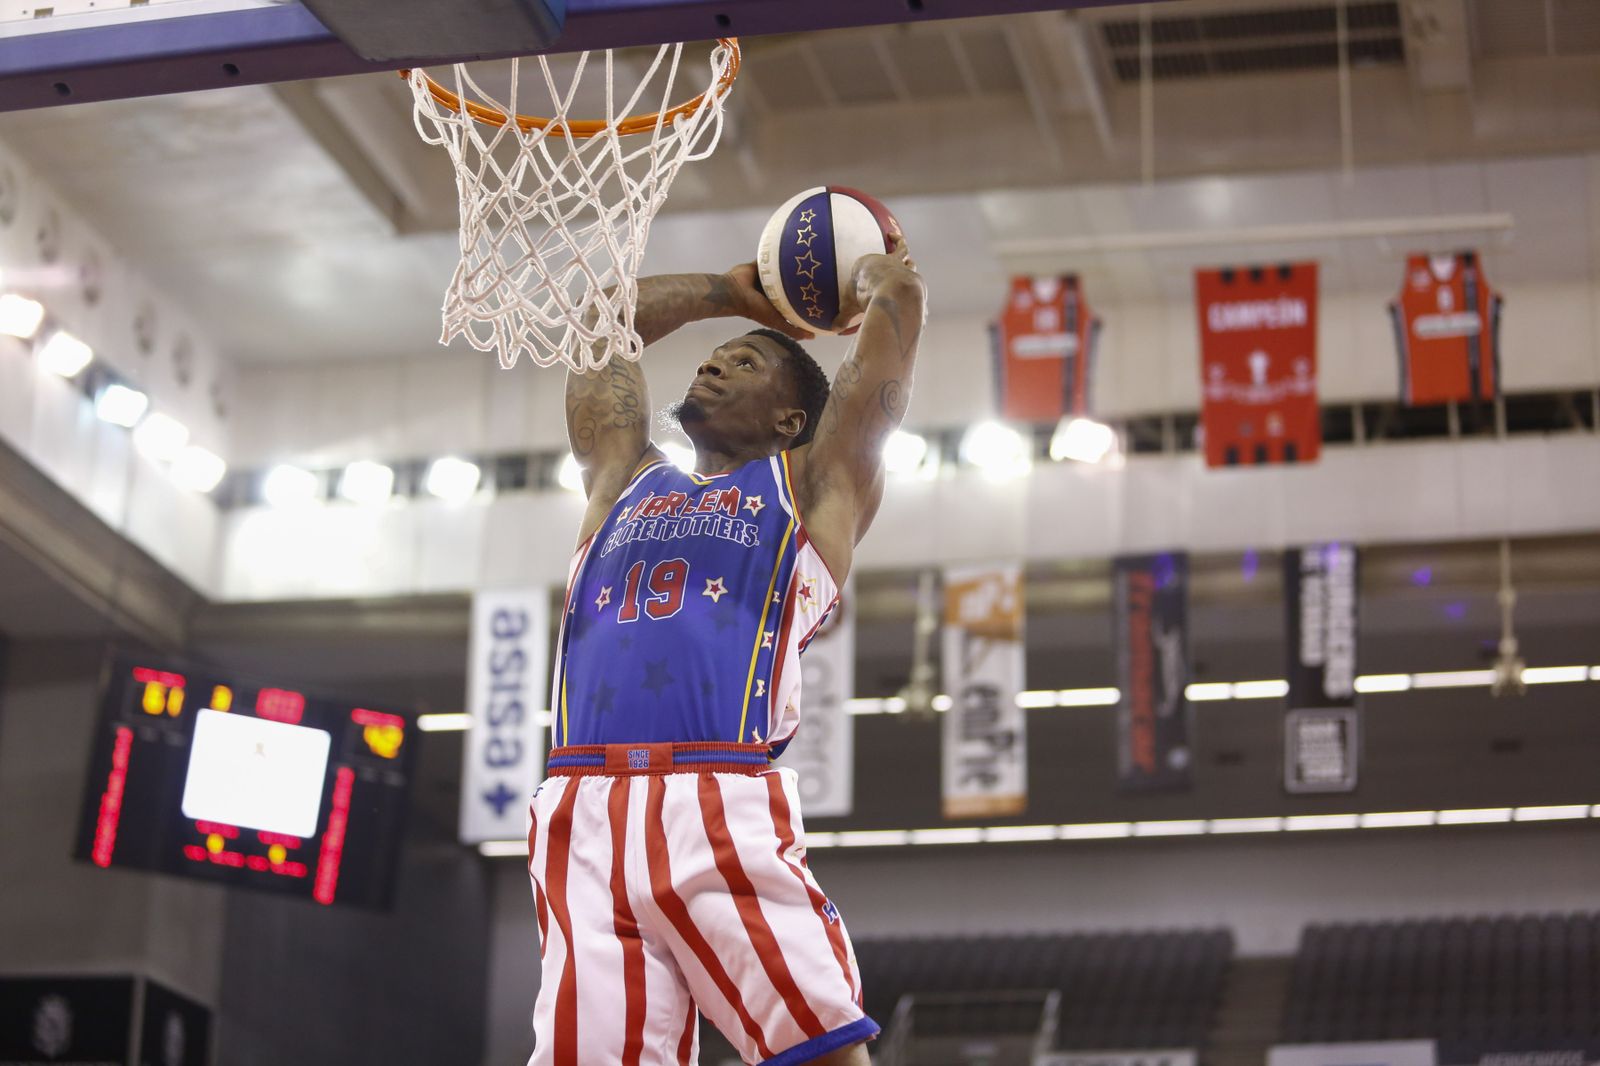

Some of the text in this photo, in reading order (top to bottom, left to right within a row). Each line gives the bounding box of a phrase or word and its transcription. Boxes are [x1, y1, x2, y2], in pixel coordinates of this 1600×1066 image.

[600, 515, 759, 558] GLOBETROTTERS
[617, 558, 690, 624] 19
[485, 608, 531, 769] asisa
[628, 749, 650, 759] SINCE
[628, 759, 650, 769] 1926
